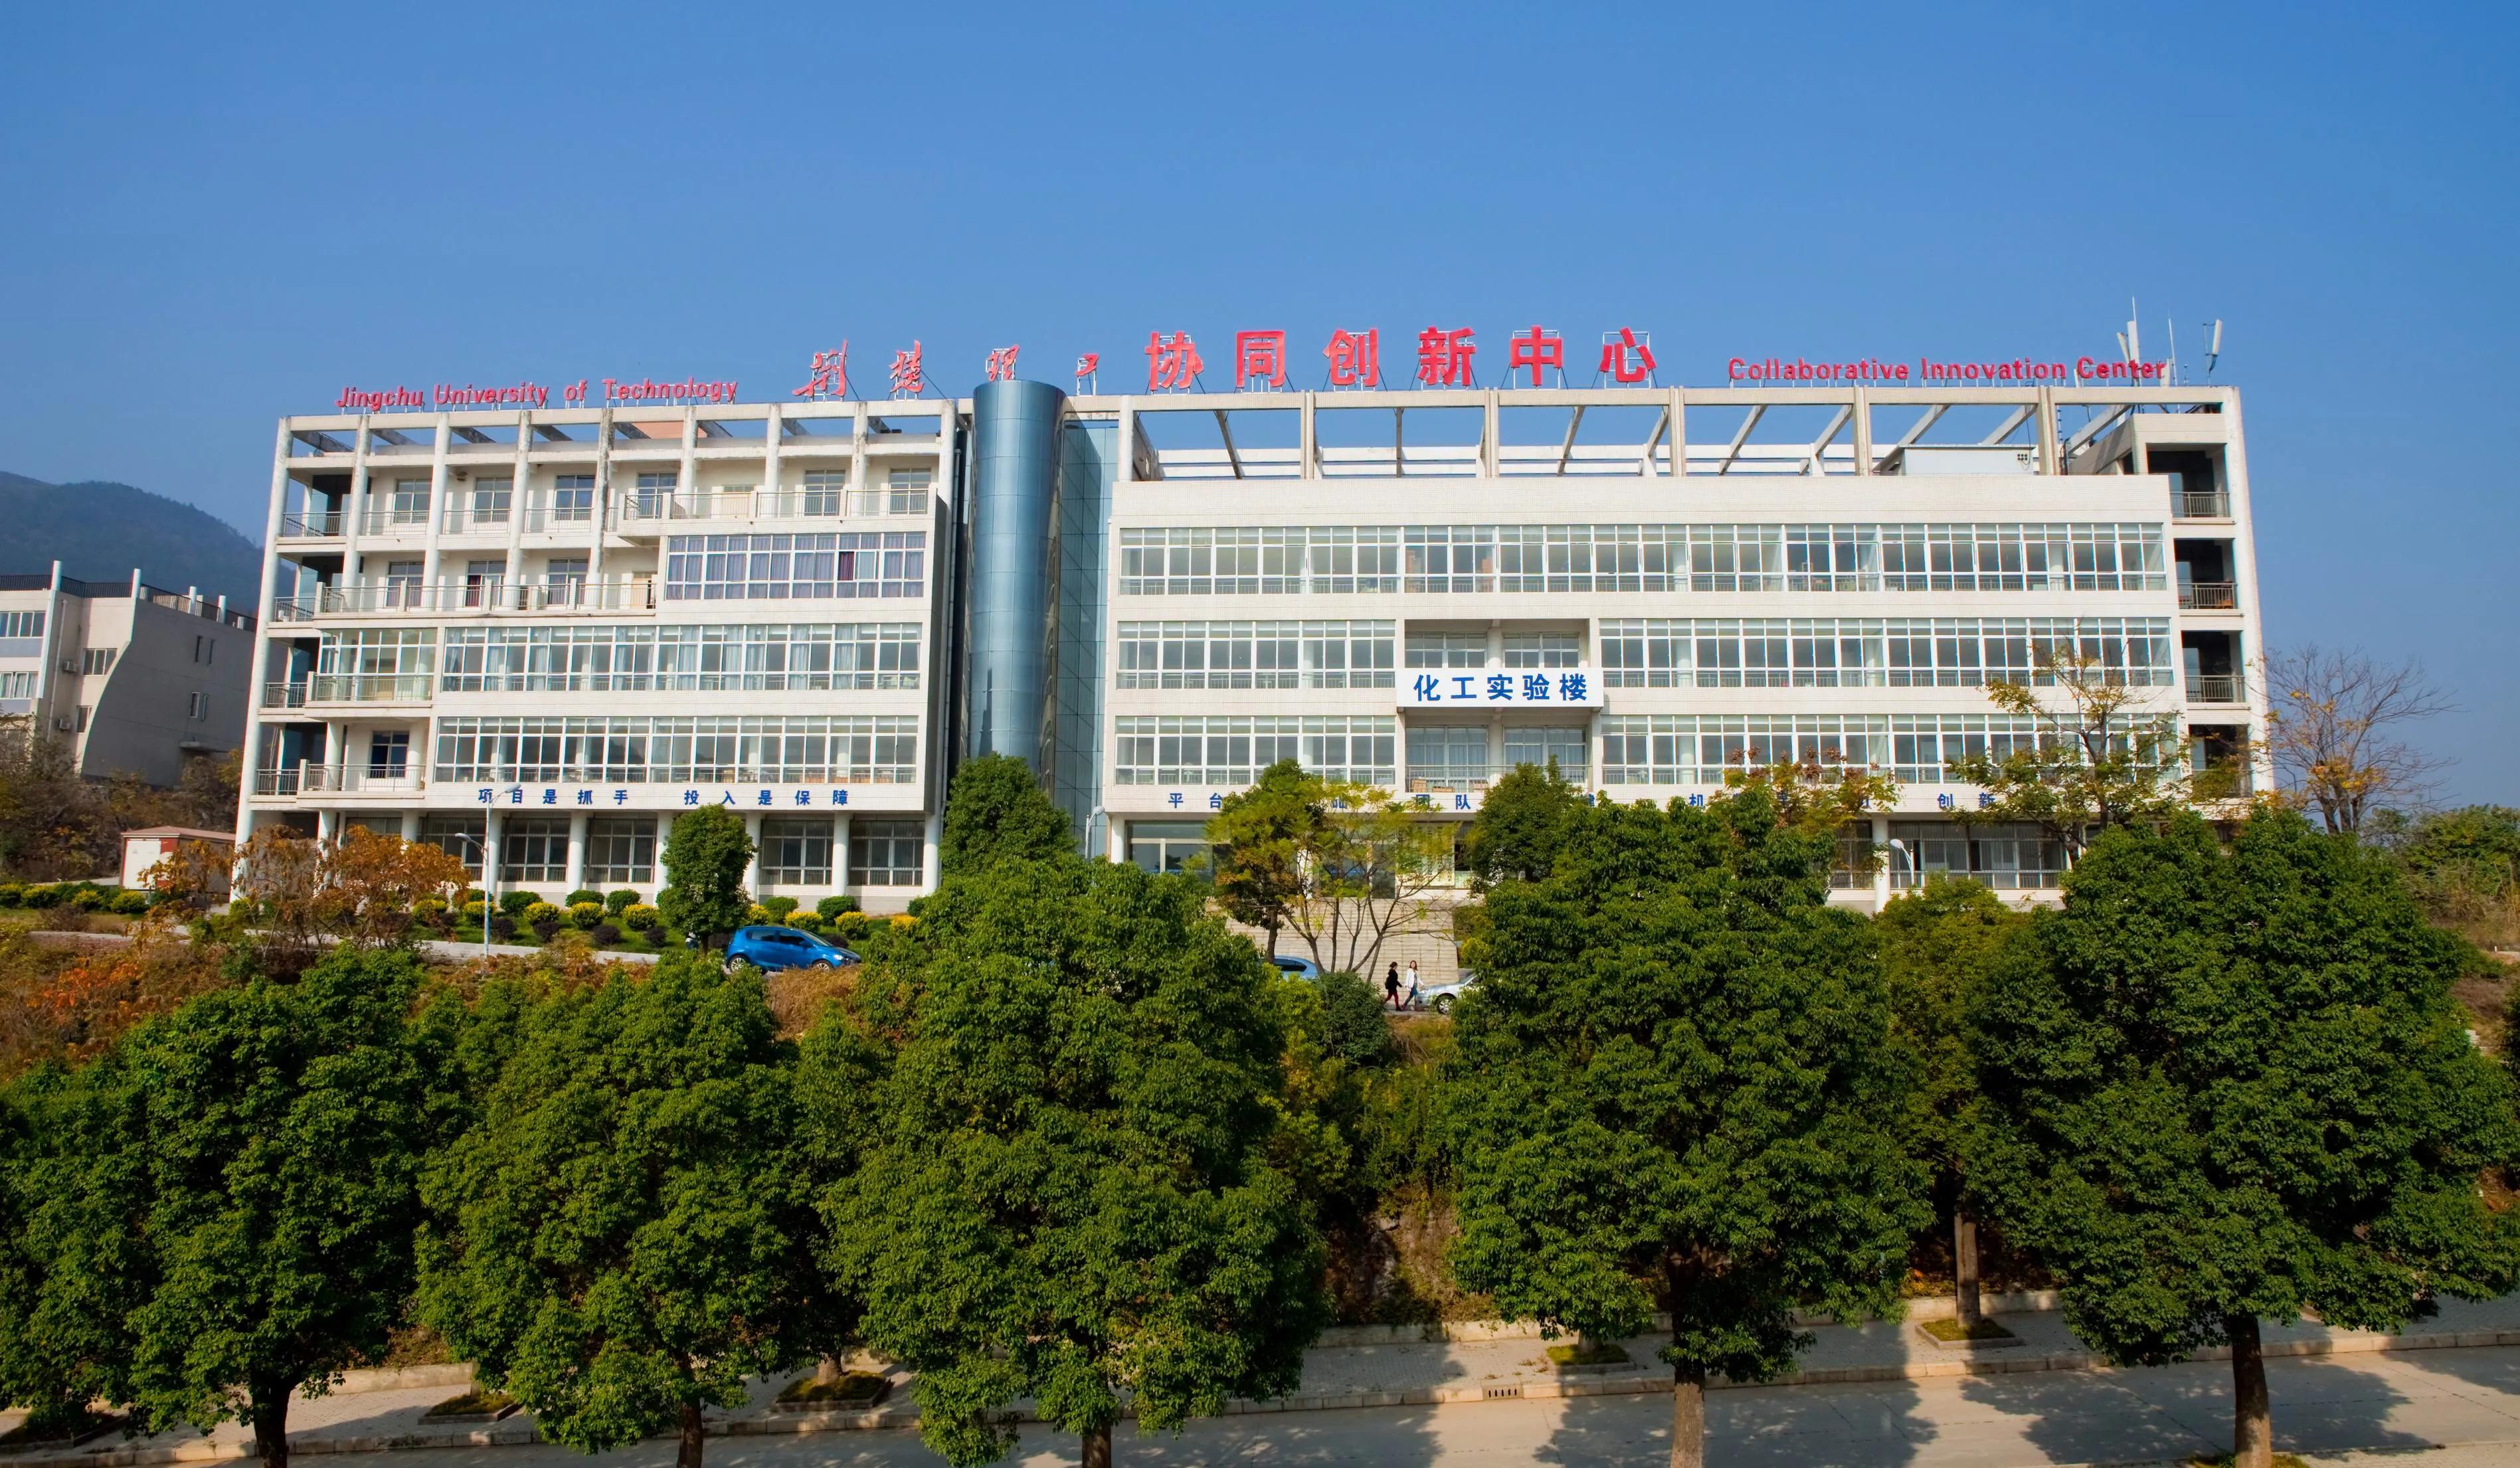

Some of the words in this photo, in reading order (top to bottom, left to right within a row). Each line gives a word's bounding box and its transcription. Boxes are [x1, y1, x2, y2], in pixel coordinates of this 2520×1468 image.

[1144, 325, 1657, 391] 协同创新中心
[1728, 357, 1909, 380] Collaborative
[1922, 357, 2066, 380] Innovation
[2076, 357, 2167, 380] Center
[335, 386, 423, 412] Jingchu
[433, 382, 549, 407] University
[563, 379, 587, 401] of
[602, 377, 737, 402] Technology
[1413, 674, 1587, 702] 化工实验楼
[478, 788, 628, 805] 项目是抓手
[684, 790, 848, 806] 投入是保障
